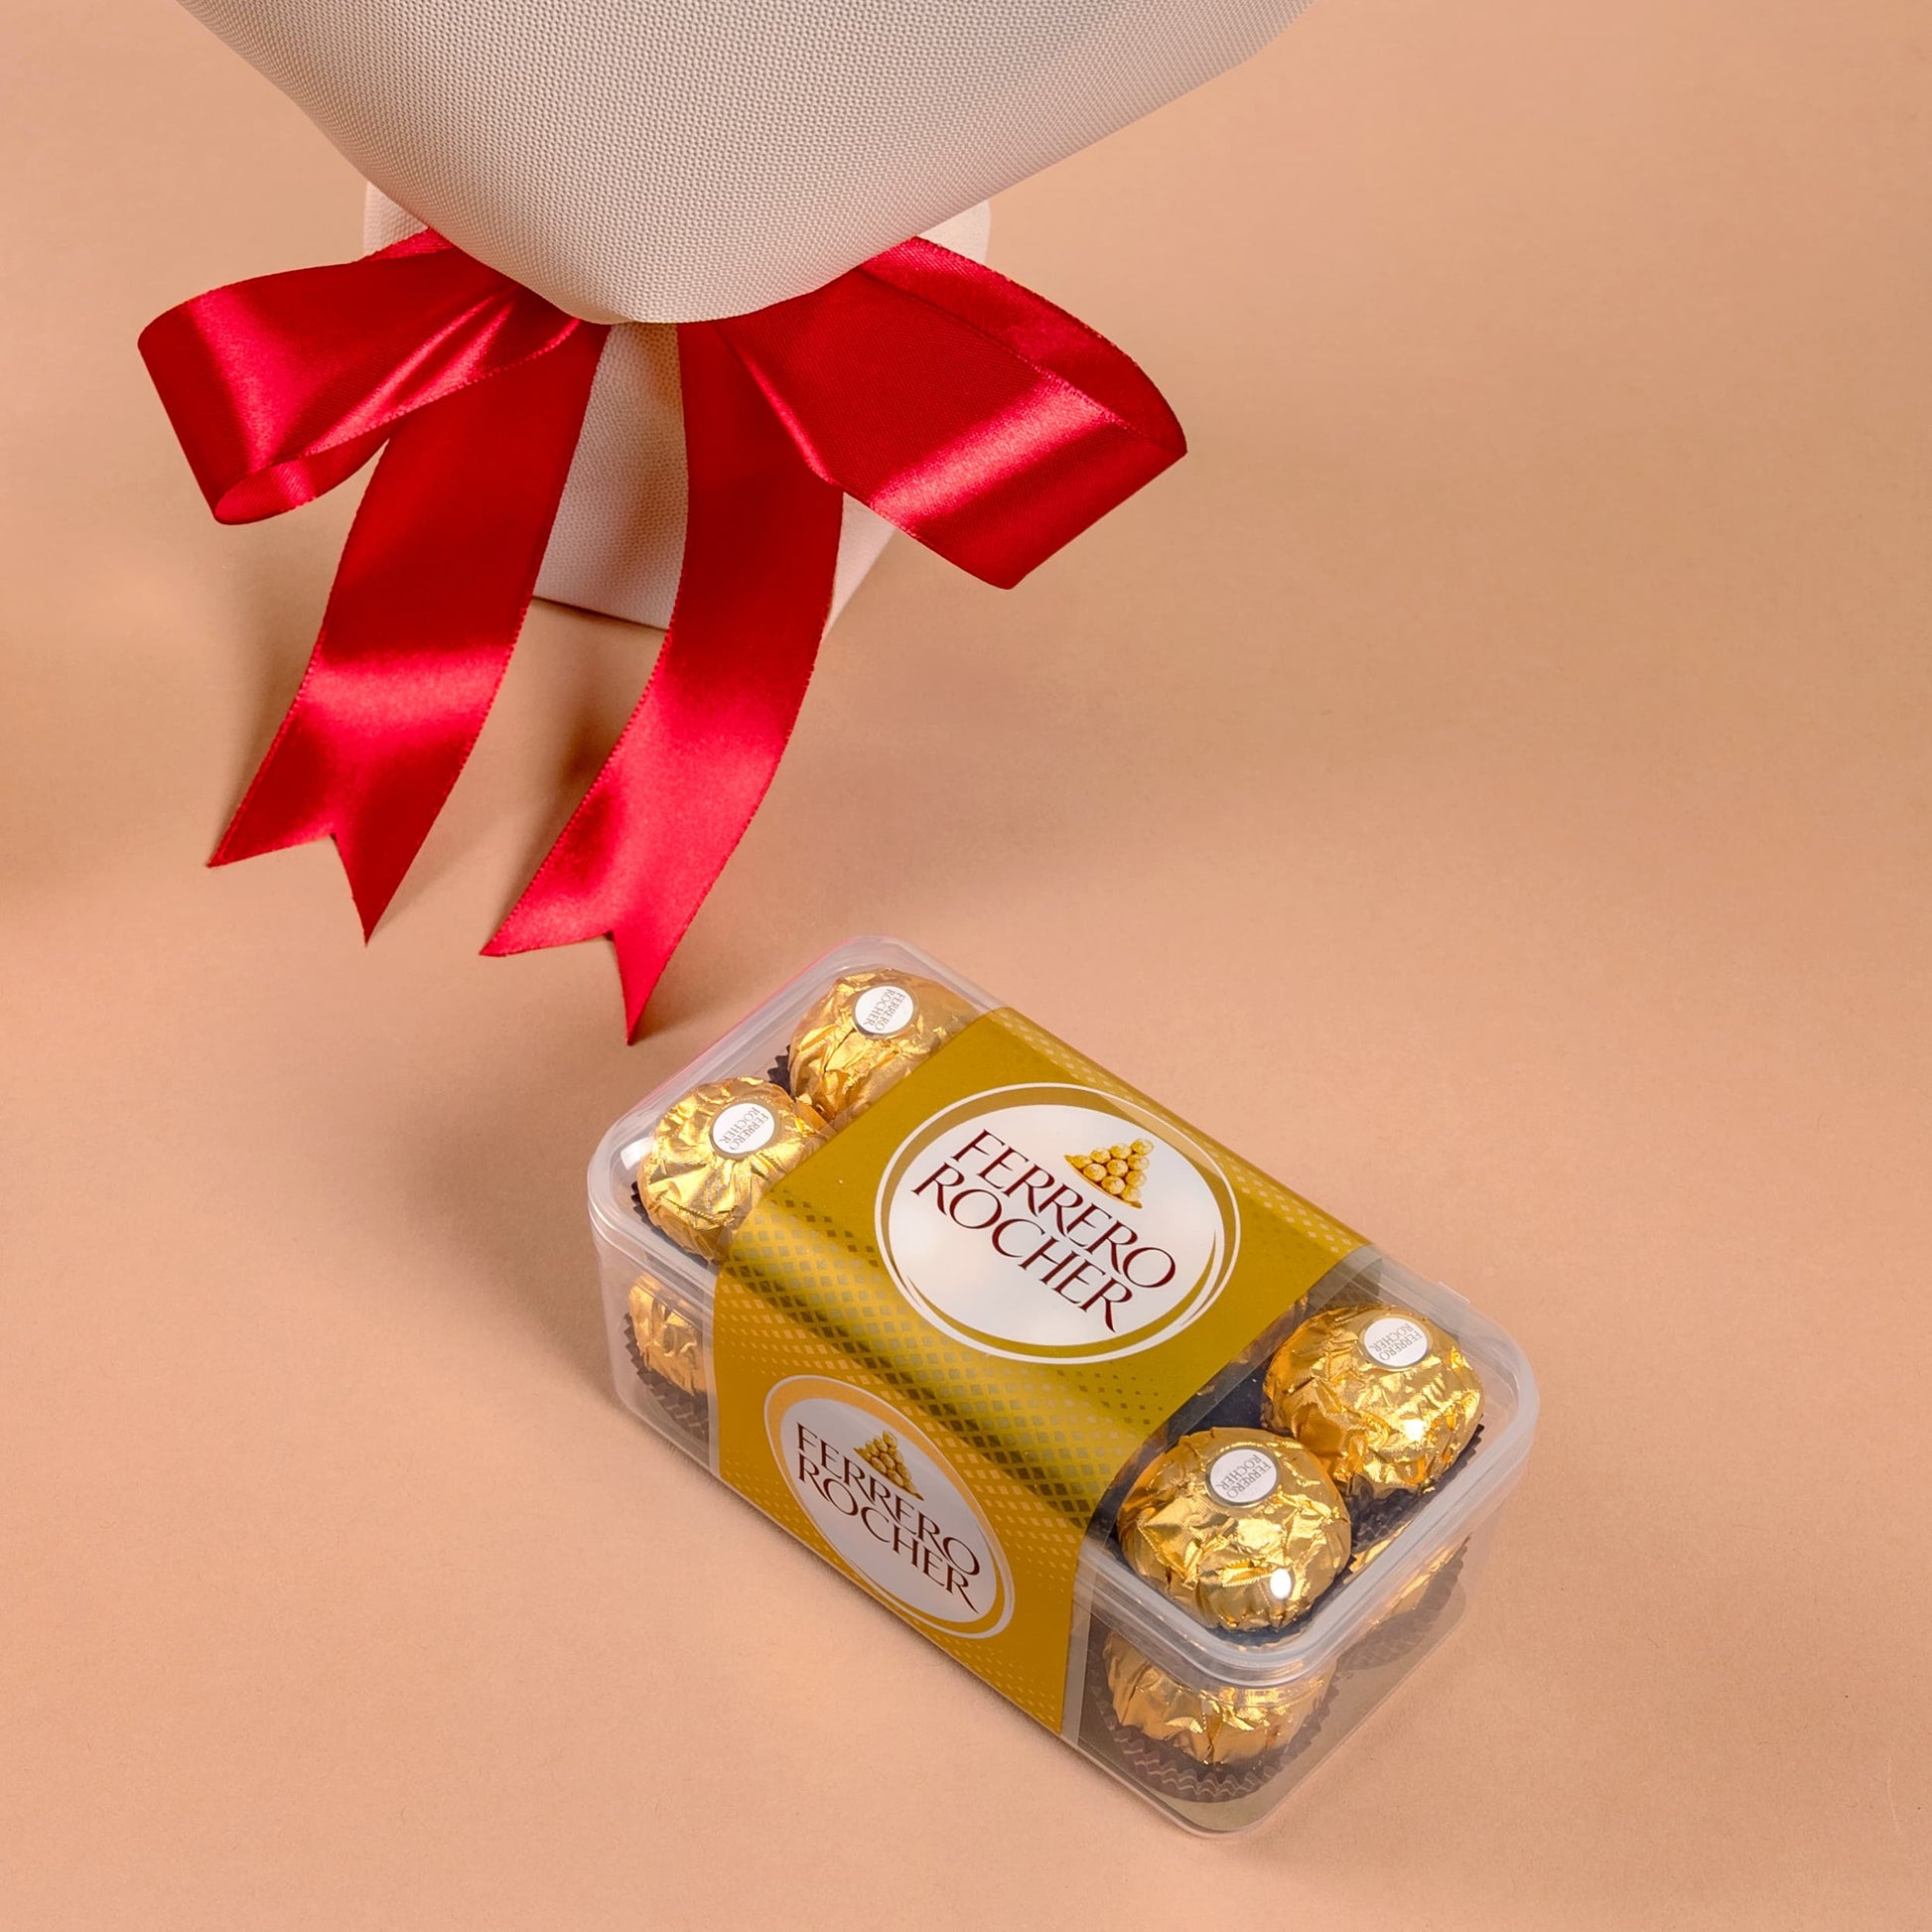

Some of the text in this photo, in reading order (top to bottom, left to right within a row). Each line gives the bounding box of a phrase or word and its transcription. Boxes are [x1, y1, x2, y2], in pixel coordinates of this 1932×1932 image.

[863, 988, 897, 1026] ROCHER
[874, 992, 906, 1032] FERRERO
[718, 1106, 760, 1144] ROCHER
[729, 1112, 769, 1151] FERRERO
[950, 1128, 1176, 1289] FERRERO
[910, 1162, 1134, 1333] ROCHER
[1214, 1453, 1263, 1490] ROCHER
[1226, 1460, 1272, 1499] FERRERO
[796, 1422, 981, 1576] FERRERO
[797, 1451, 980, 1614] ROCHER
